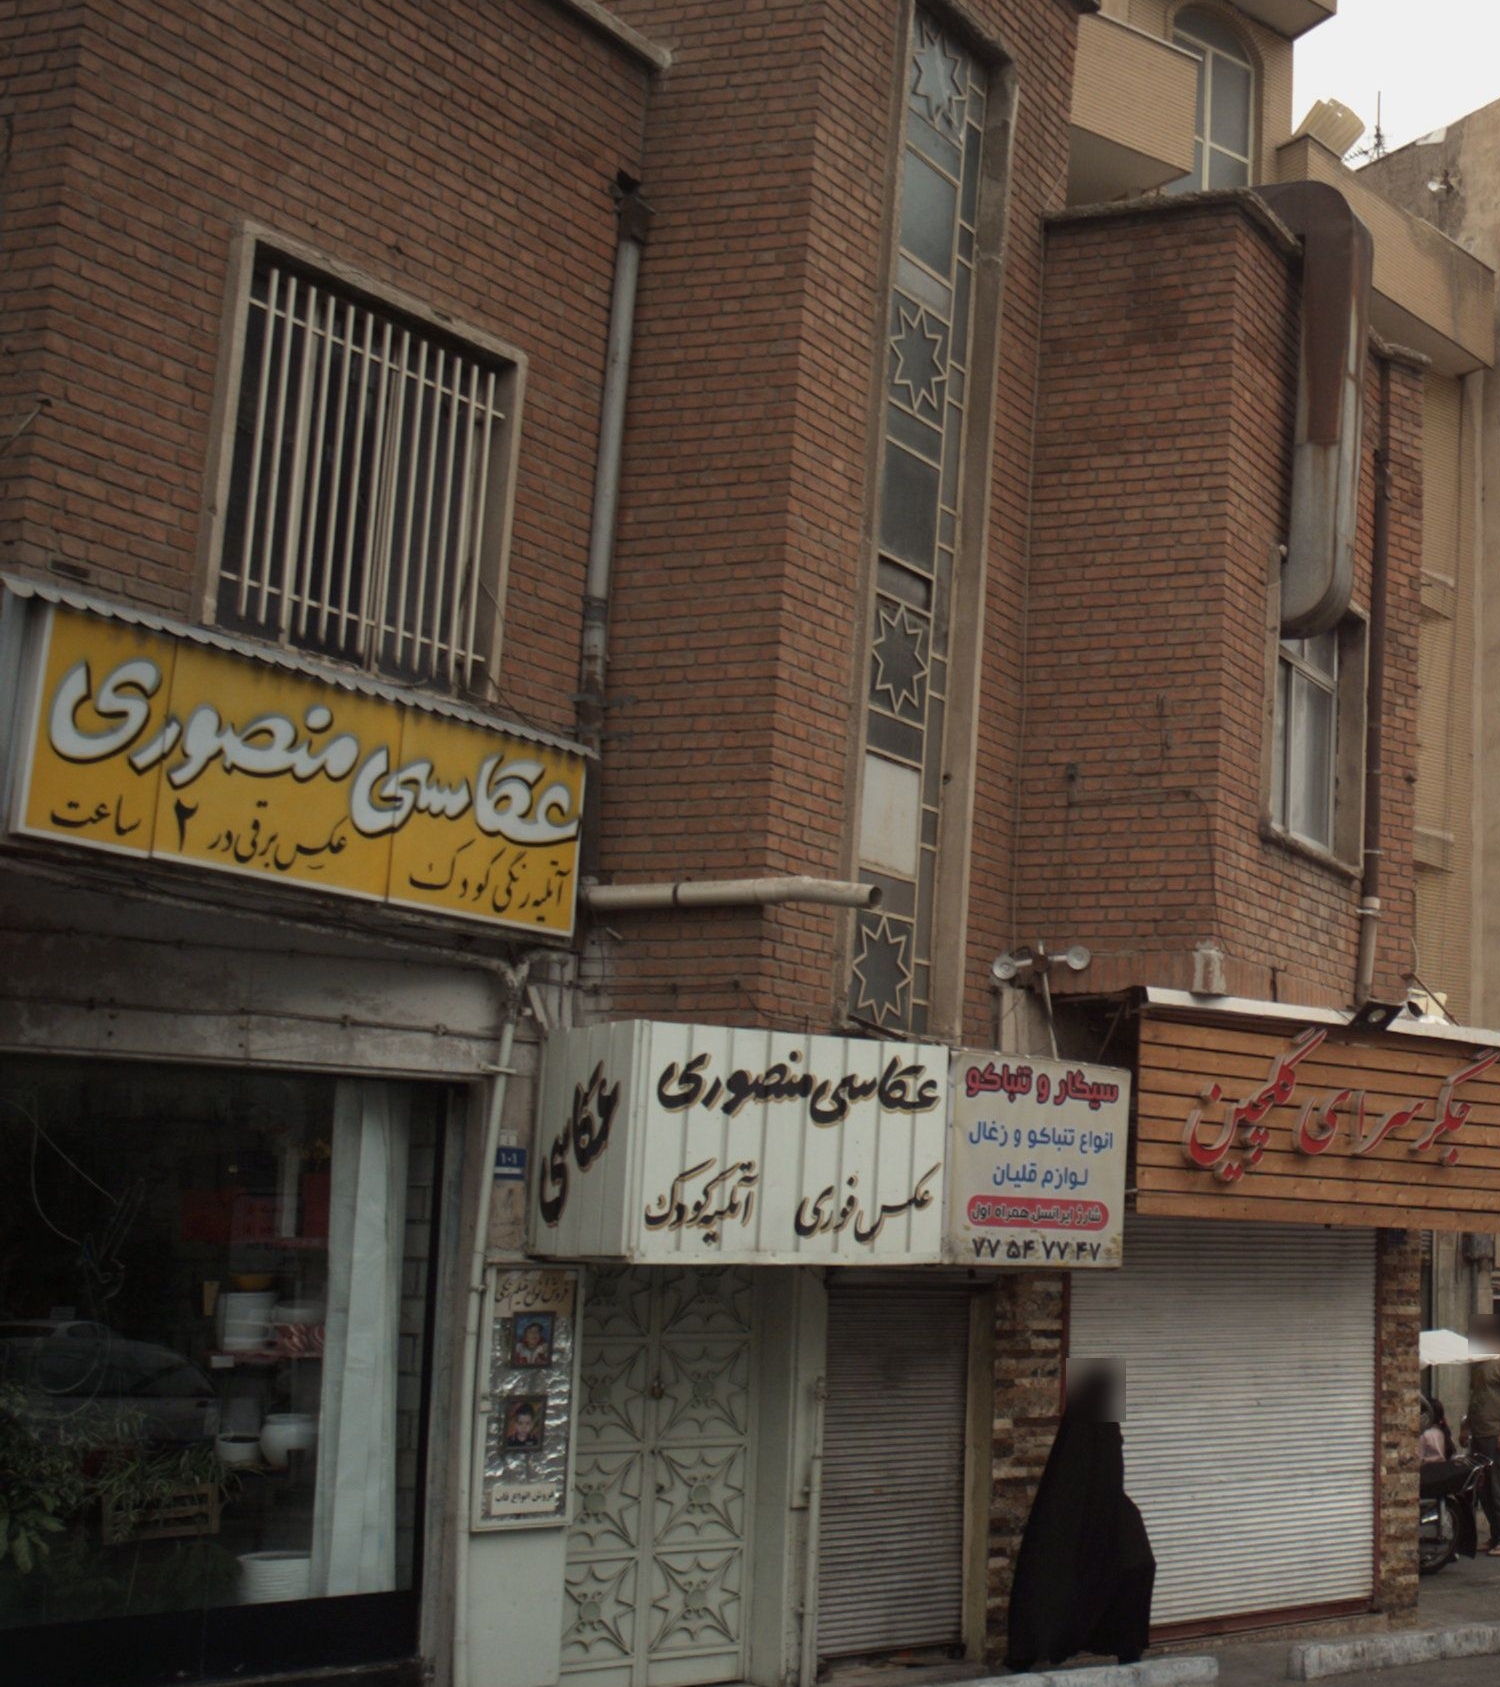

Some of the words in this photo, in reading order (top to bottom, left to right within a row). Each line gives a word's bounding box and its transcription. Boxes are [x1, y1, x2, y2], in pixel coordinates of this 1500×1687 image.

[49, 657, 360, 788] منصوری
[50, 794, 141, 837] ساعت
[175, 796, 199, 852] ۲
[350, 747, 582, 846] عکاسی
[207, 829, 233, 852] در
[234, 800, 278, 868] برقی
[274, 814, 349, 871] عکس
[408, 839, 507, 902] کودک
[491, 851, 527, 913] رنگی
[532, 860, 572, 921] آتلیه
[657, 1050, 817, 1118] منصوری
[809, 1054, 940, 1128] عکاسی
[965, 1061, 1033, 1103] تنباکو
[1036, 1072, 1051, 1104] و
[1053, 1068, 1120, 1111] سیگار
[1184, 1027, 1328, 1182] گلچین
[540, 1060, 621, 1229] عکاسی
[968, 1120, 1009, 1147] زغال
[1013, 1128, 1022, 1148] و
[1027, 1126, 1075, 1151] تنباکو
[1079, 1130, 1114, 1154] انواع
[644, 1156, 742, 1231] کودک
[698, 1160, 759, 1244] آتلیه
[854, 1161, 942, 1244] عکس
[992, 1162, 1038, 1188] قلیان
[1041, 1166, 1089, 1191] لوازم
[794, 1174, 859, 1239] فوری
[971, 1202, 991, 1221] اول
[994, 1203, 1030, 1222] همراه
[1076, 1204, 1102, 1225] شارژ
[972, 1237, 1001, 1258] ۷۷
[1006, 1239, 1035, 1260] ۵۴
[1042, 1239, 1070, 1260] ۷۷
[1075, 1241, 1102, 1261] ۴۷
